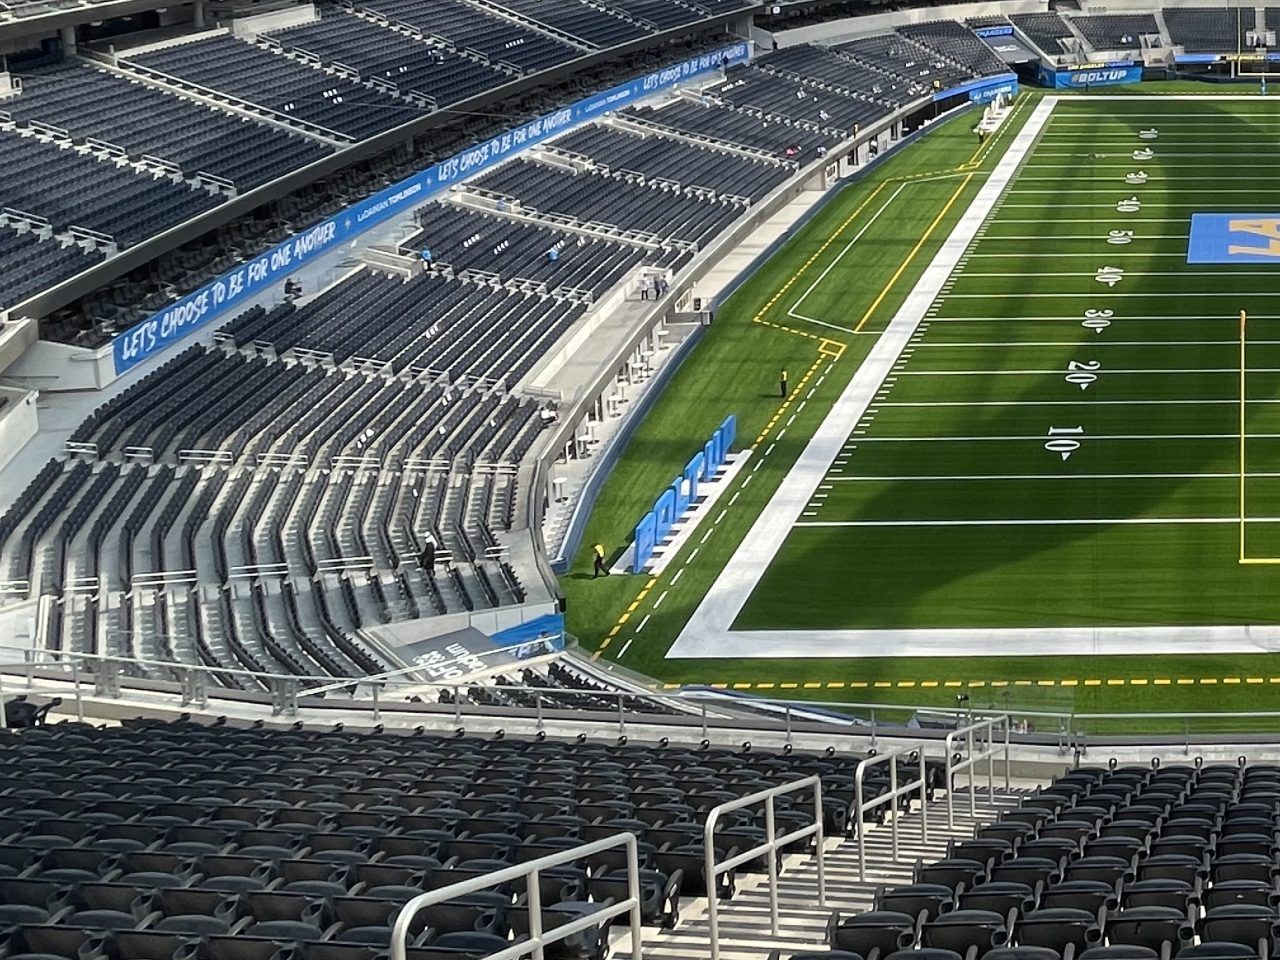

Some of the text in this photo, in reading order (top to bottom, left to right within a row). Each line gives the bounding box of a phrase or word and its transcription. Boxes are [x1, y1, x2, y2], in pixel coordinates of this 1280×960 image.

[437, 108, 572, 181] LET'S CHOOSE TO BE FOR ONE ANOTHER
[1107, 230, 1133, 244] 50
[1095, 266, 1124, 283] 40
[121, 220, 336, 361] LET'S CHOOSE TO BE FOR ONE ANOTHER
[1081, 309, 1114, 328] 30
[1065, 360, 1101, 384] 20
[1044, 425, 1084, 452] 10
